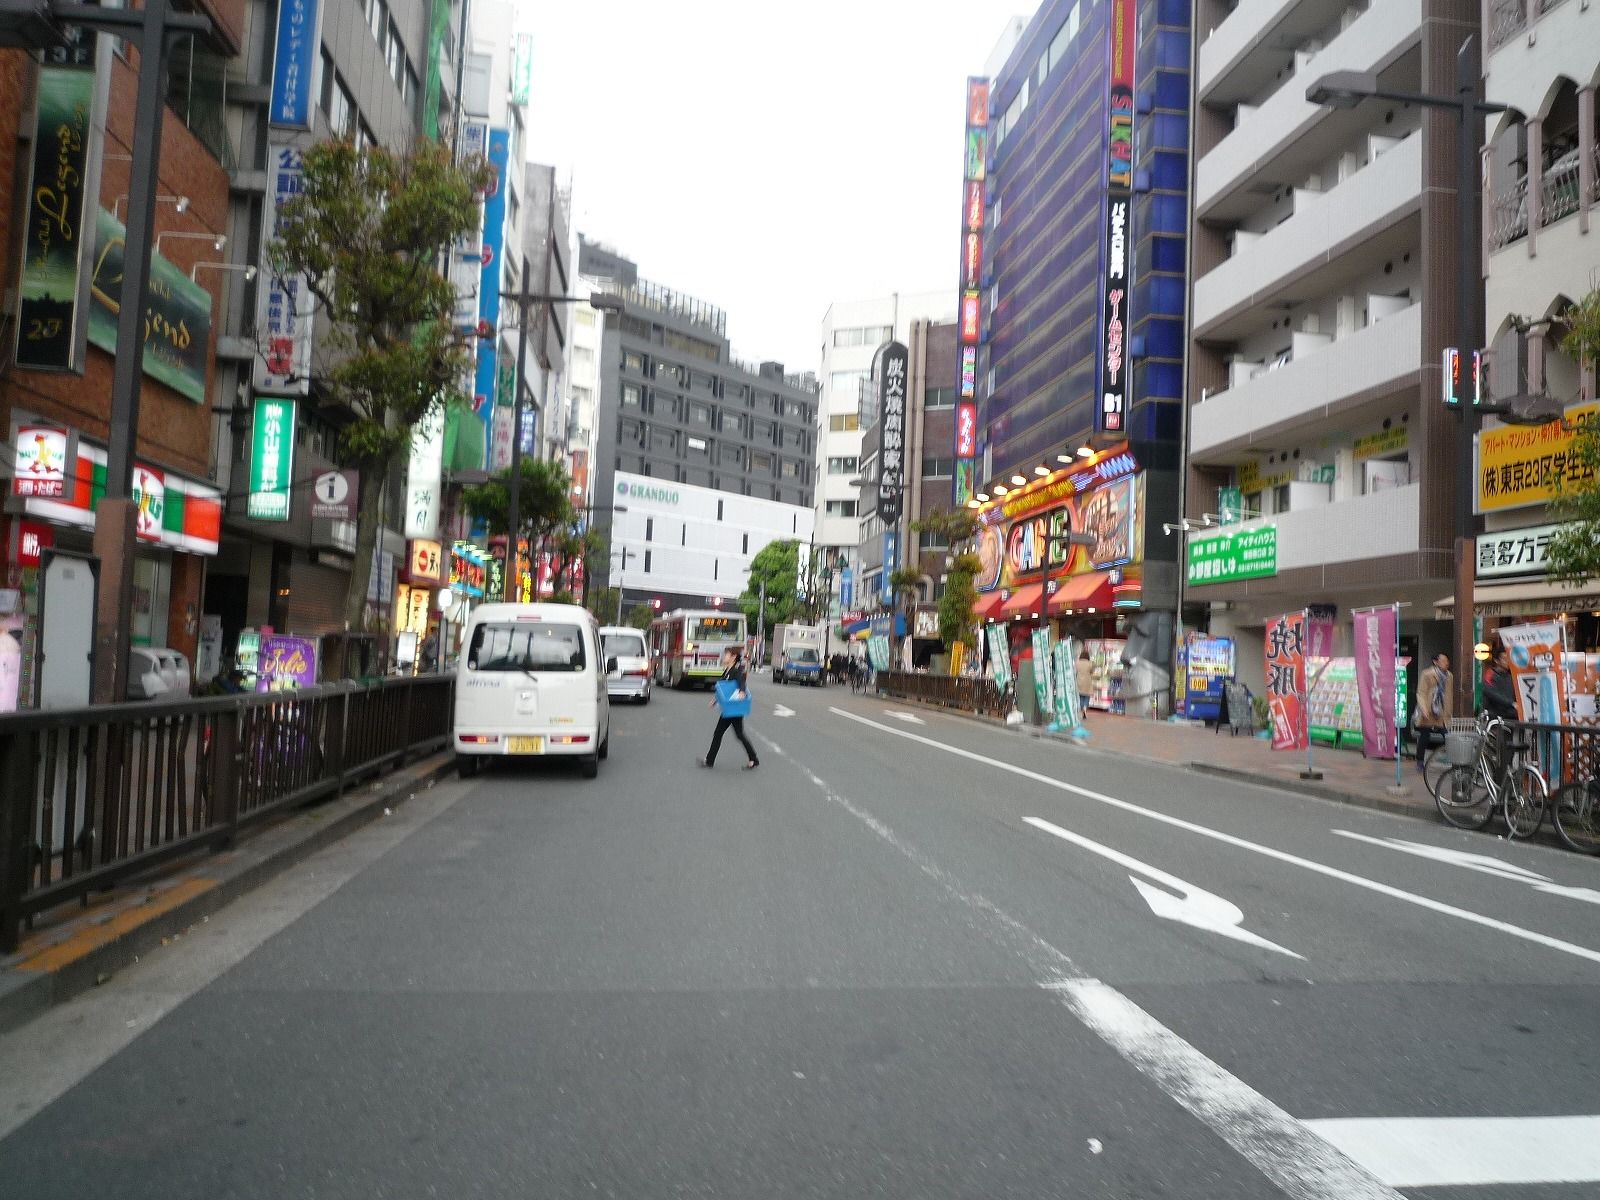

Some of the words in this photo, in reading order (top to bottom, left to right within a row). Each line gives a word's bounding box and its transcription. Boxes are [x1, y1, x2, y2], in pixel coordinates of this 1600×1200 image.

[1111, 95, 1133, 188] SILKHAT
[1108, 289, 1123, 386] ゲームセンター
[630, 481, 679, 504] GRANDUO
